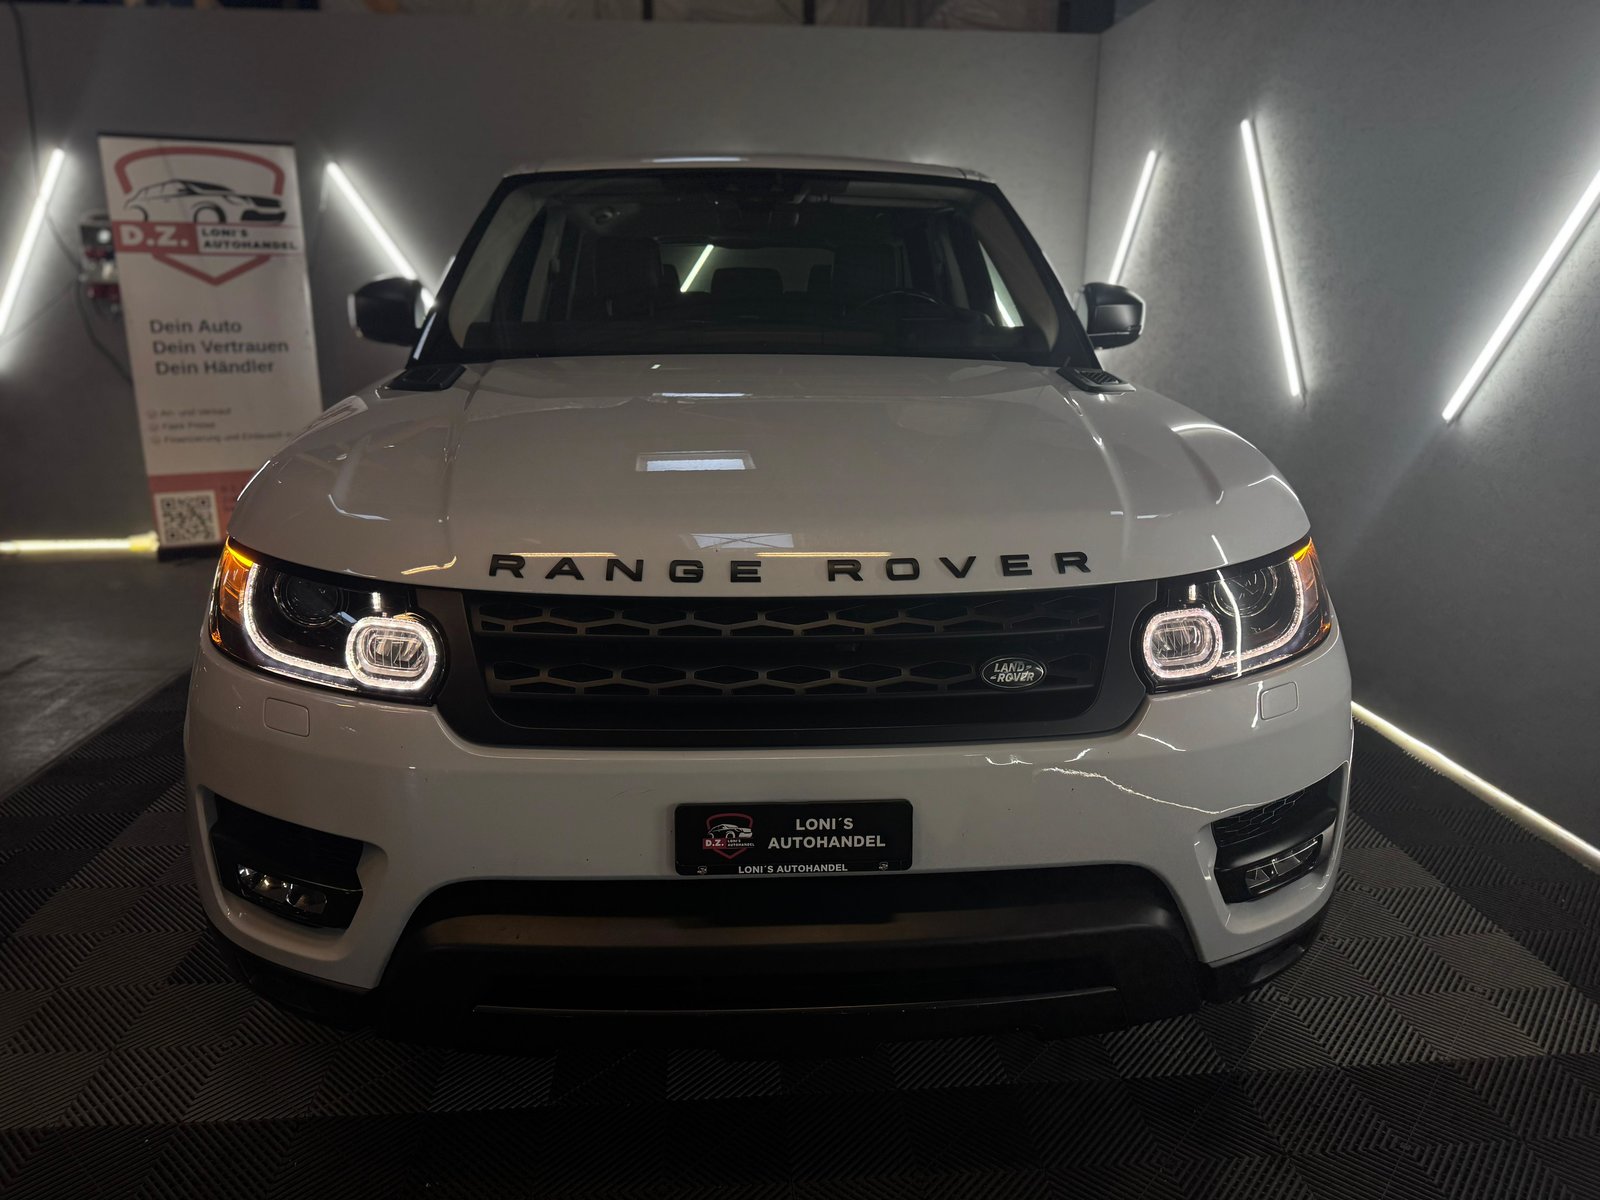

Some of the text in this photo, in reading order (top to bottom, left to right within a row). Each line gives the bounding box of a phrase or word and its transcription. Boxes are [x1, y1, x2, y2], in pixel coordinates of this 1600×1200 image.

[119, 224, 189, 246] D.Z.
[204, 239, 297, 250] AUTOHANDEL
[150, 319, 242, 334] Dein Auto
[153, 340, 289, 354] Dein Vertrauen
[156, 359, 274, 375] Dein Händler
[489, 551, 1091, 583] RANGE ROVER
[994, 662, 1025, 673] LAND
[996, 671, 1035, 683] ROVER
[705, 839, 724, 847] D.Z.
[767, 835, 886, 849] AUTOHANDEL
[776, 864, 848, 873] AUTOHANDEL
